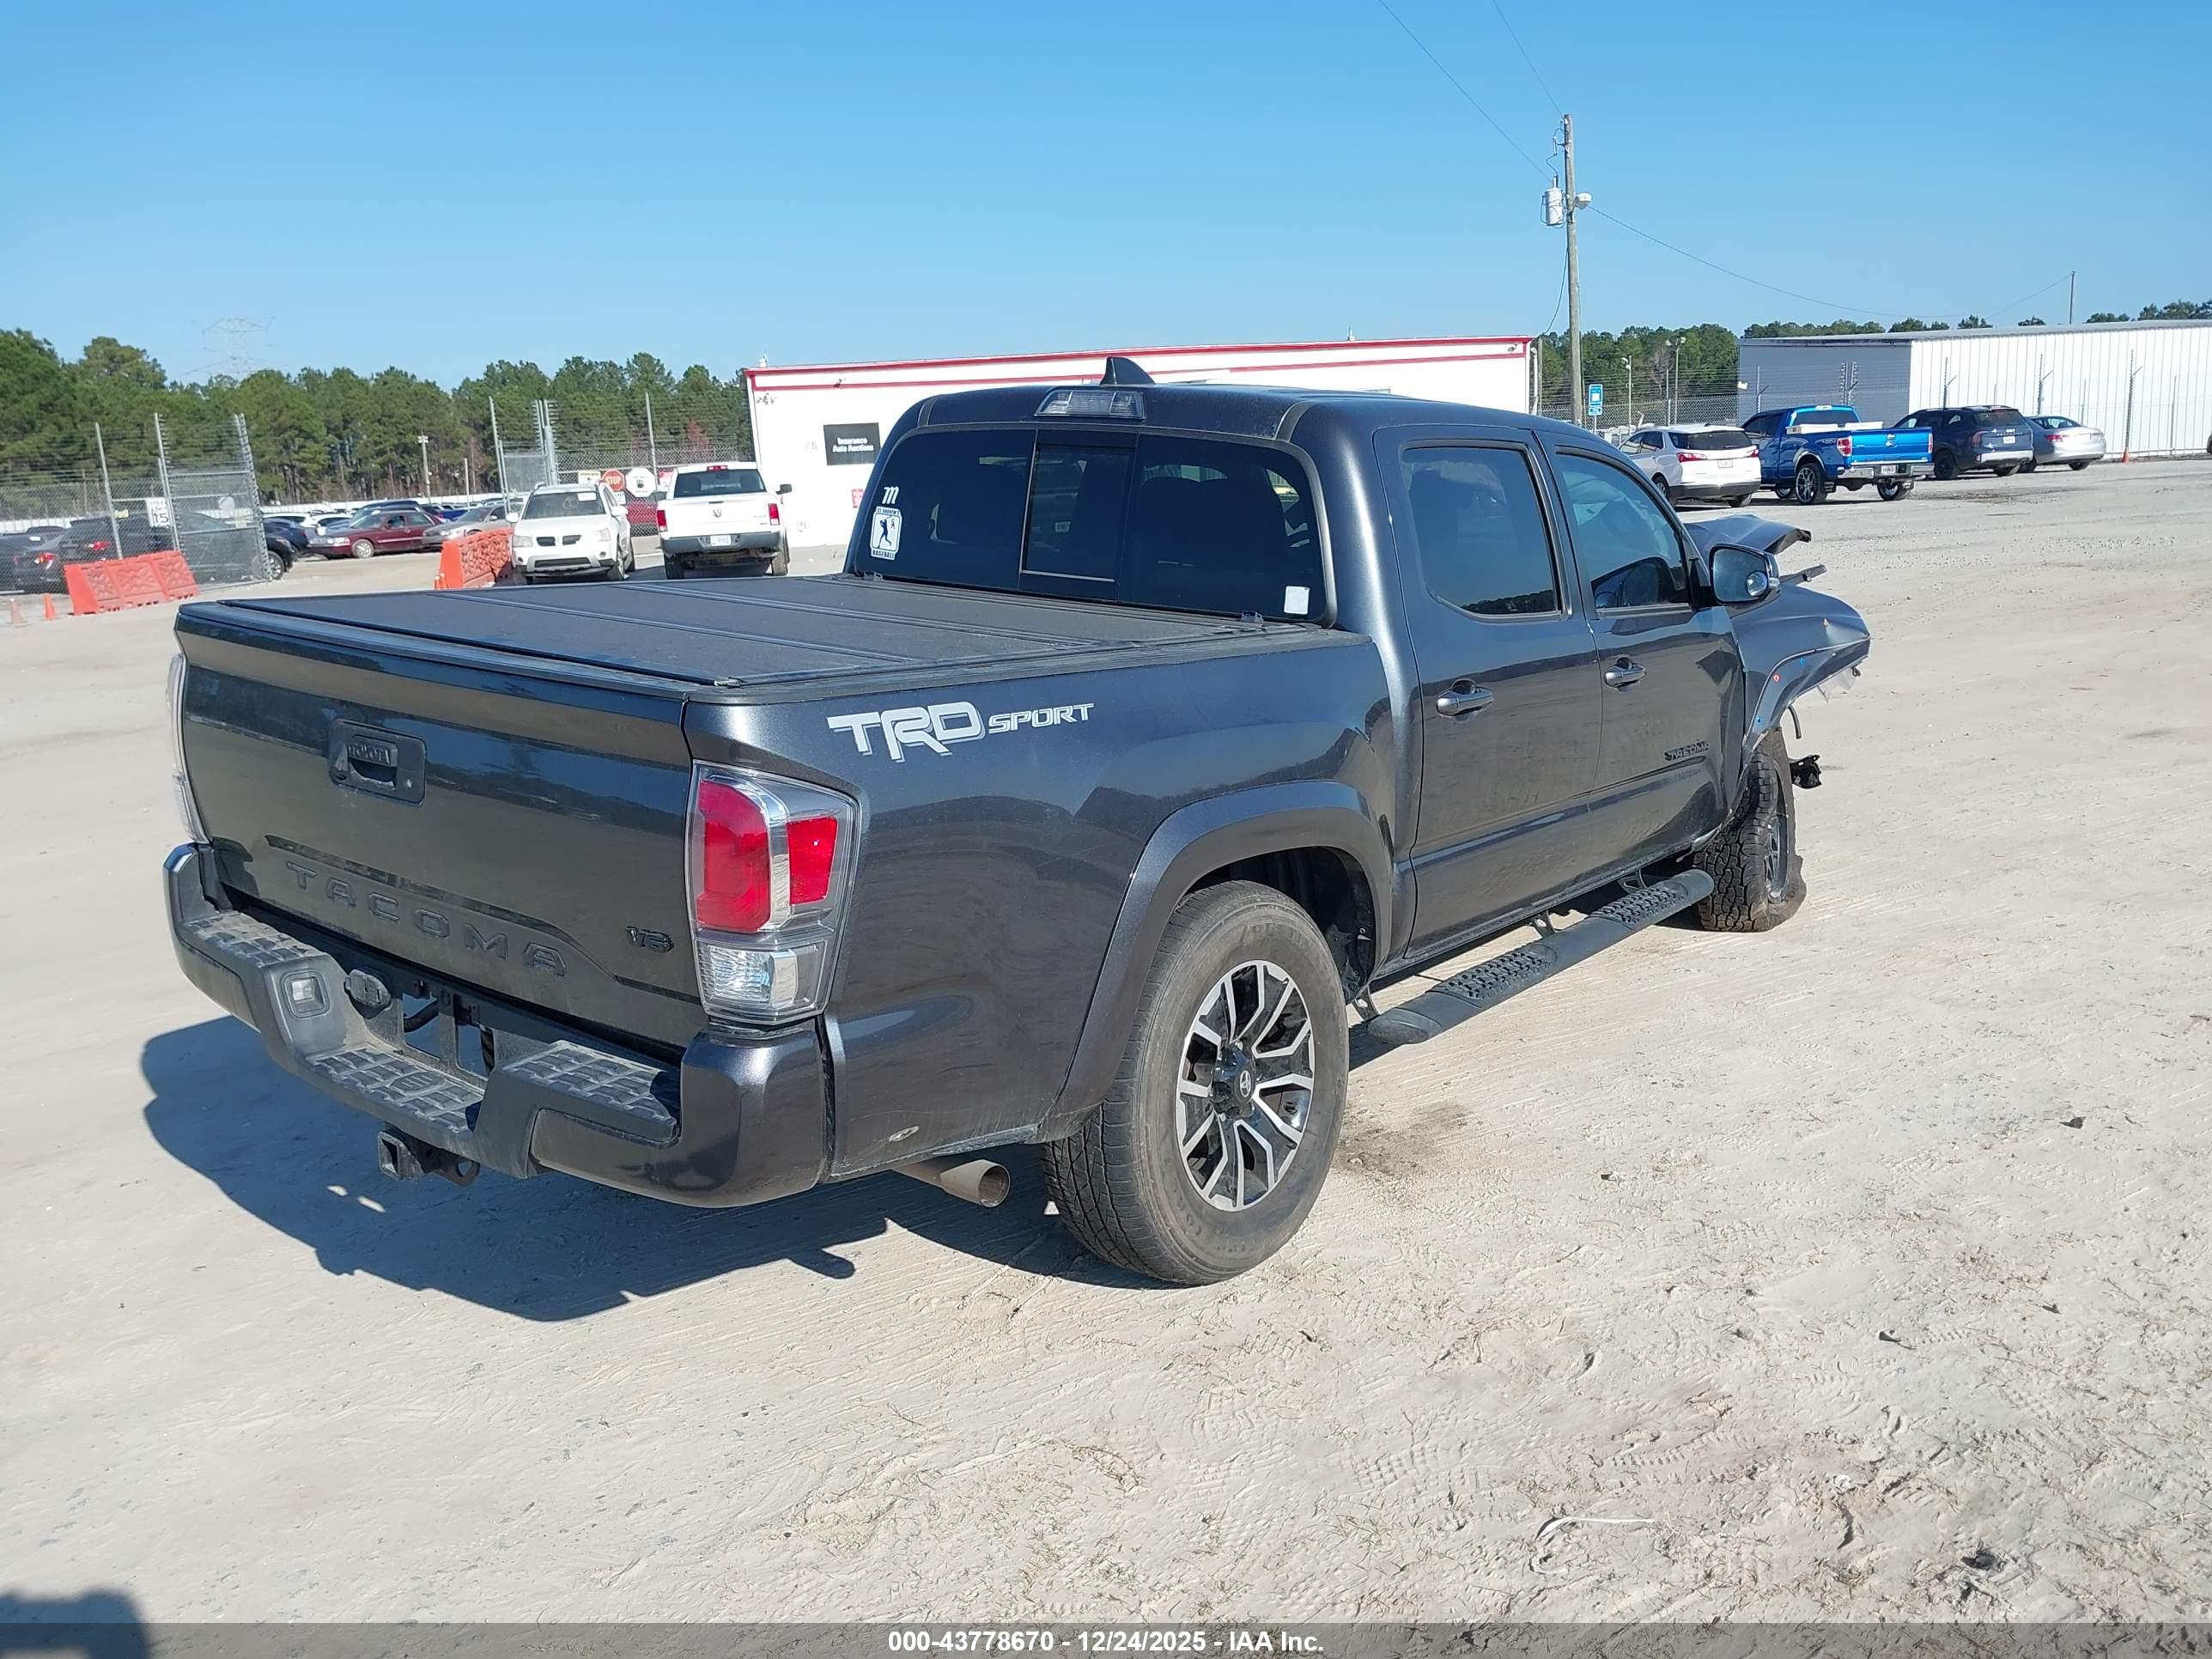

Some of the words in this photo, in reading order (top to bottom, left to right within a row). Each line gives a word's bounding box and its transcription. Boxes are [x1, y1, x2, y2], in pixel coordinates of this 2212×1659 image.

[837, 437, 867, 446] Insurance
[604, 475, 622, 486] STOP
[154, 513, 169, 523] 15
[872, 549, 895, 560] BASEBALL
[825, 701, 986, 763] TRD
[988, 702, 1095, 734] SPORT
[348, 742, 392, 765] TOYOTA
[1664, 741, 1710, 762] TACOMA
[285, 861, 568, 977] TACOMA
[625, 926, 675, 953] V6
